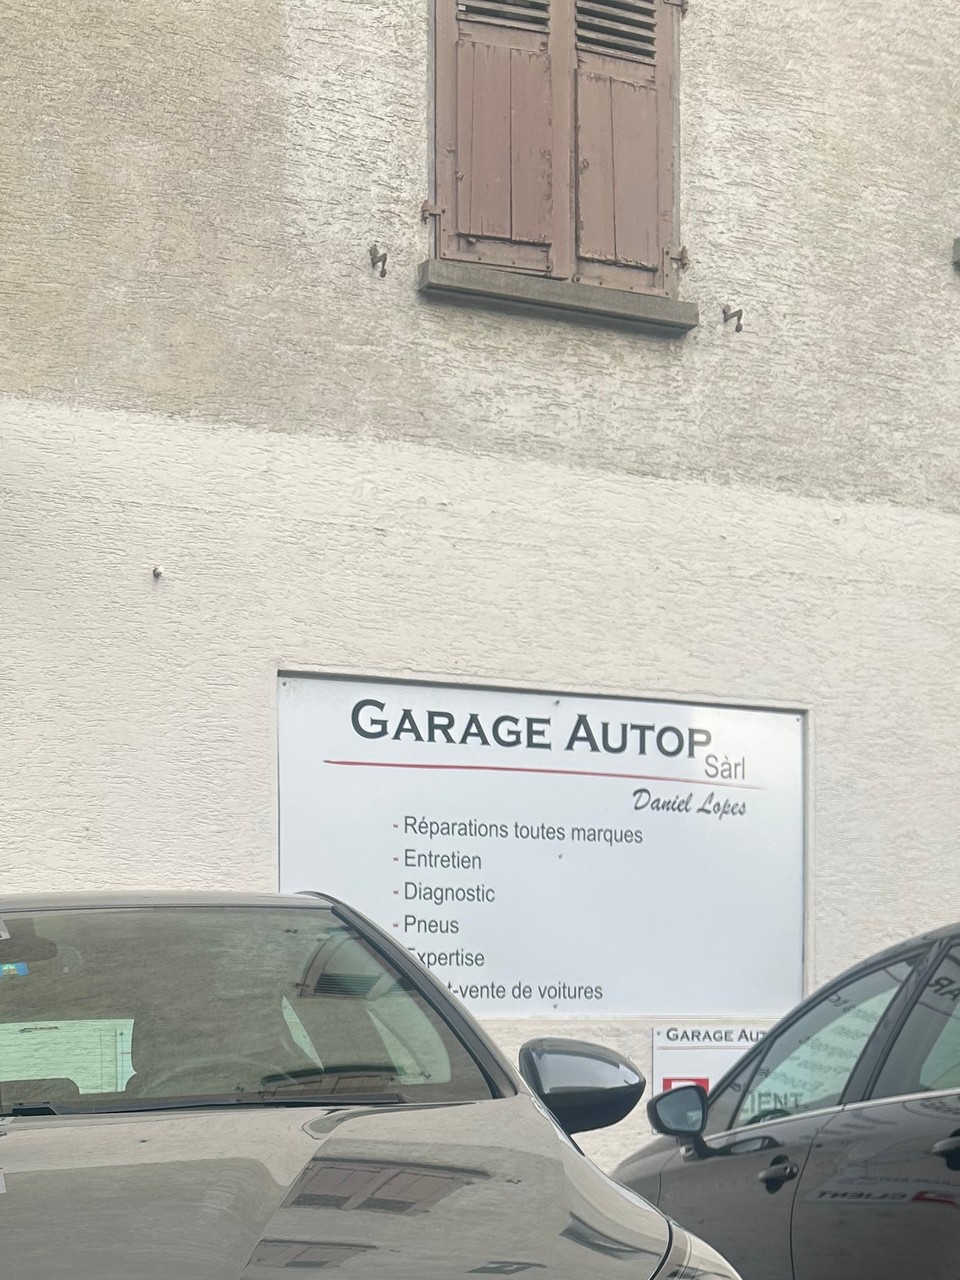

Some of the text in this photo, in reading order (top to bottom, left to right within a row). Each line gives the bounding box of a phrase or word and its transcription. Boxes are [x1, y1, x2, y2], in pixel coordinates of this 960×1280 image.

[350, 698, 746, 780] GARAGE AUTOP Sàrl
[632, 788, 747, 821] Daniel Lopes
[404, 816, 643, 847] Réparations toutes marques
[404, 849, 482, 870] Entretien
[404, 881, 496, 906] Diagnostic
[404, 914, 460, 935] Pneus
[511, 981, 532, 1000] de
[537, 981, 603, 1000] voitures
[666, 1026, 734, 1043] GARAGE
